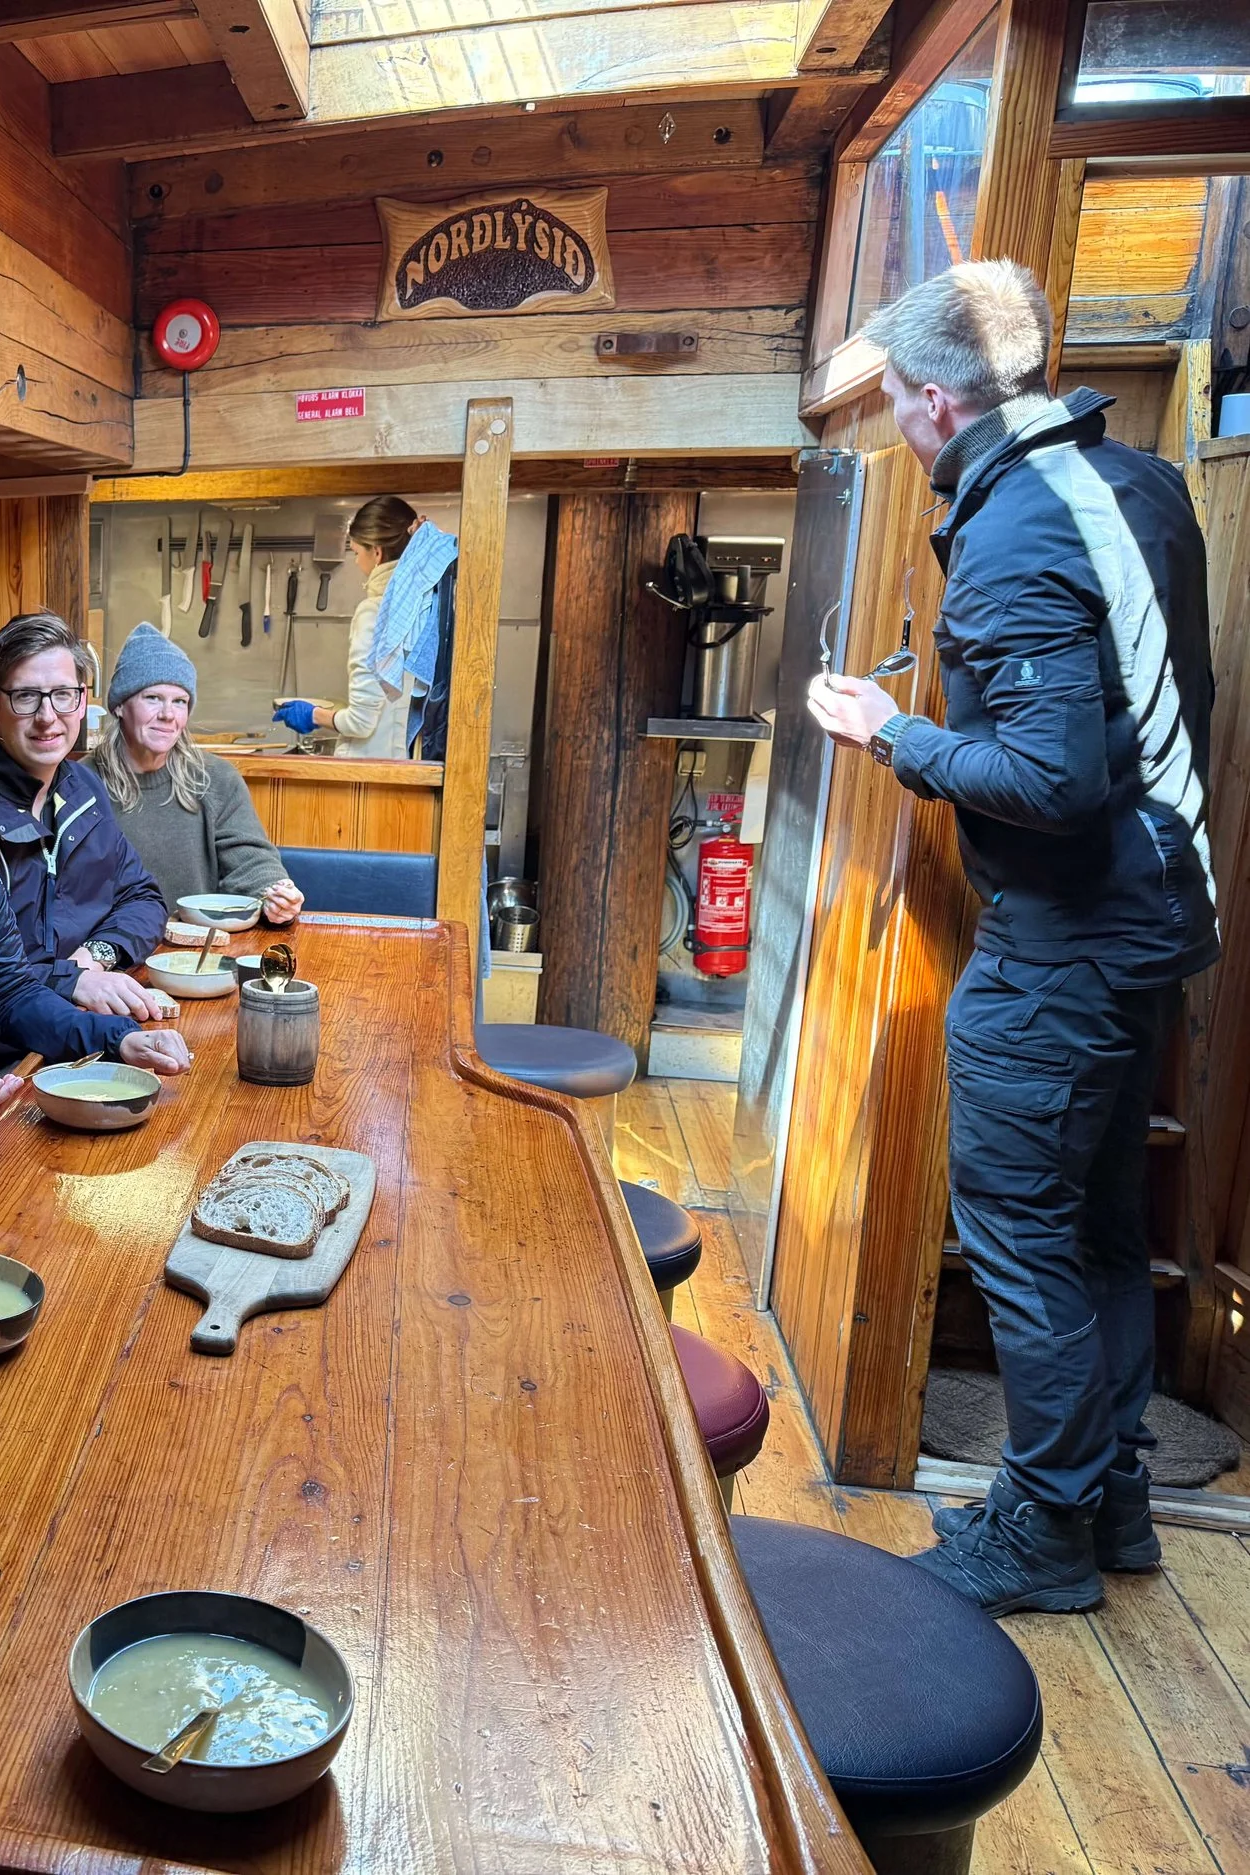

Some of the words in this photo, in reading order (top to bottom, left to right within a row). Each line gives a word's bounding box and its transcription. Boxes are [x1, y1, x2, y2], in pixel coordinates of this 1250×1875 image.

[320, 391, 339, 401] ALARM
[297, 410, 321, 420] GENERAL
[324, 408, 343, 418] ALARM
[345, 406, 359, 416] BELL
